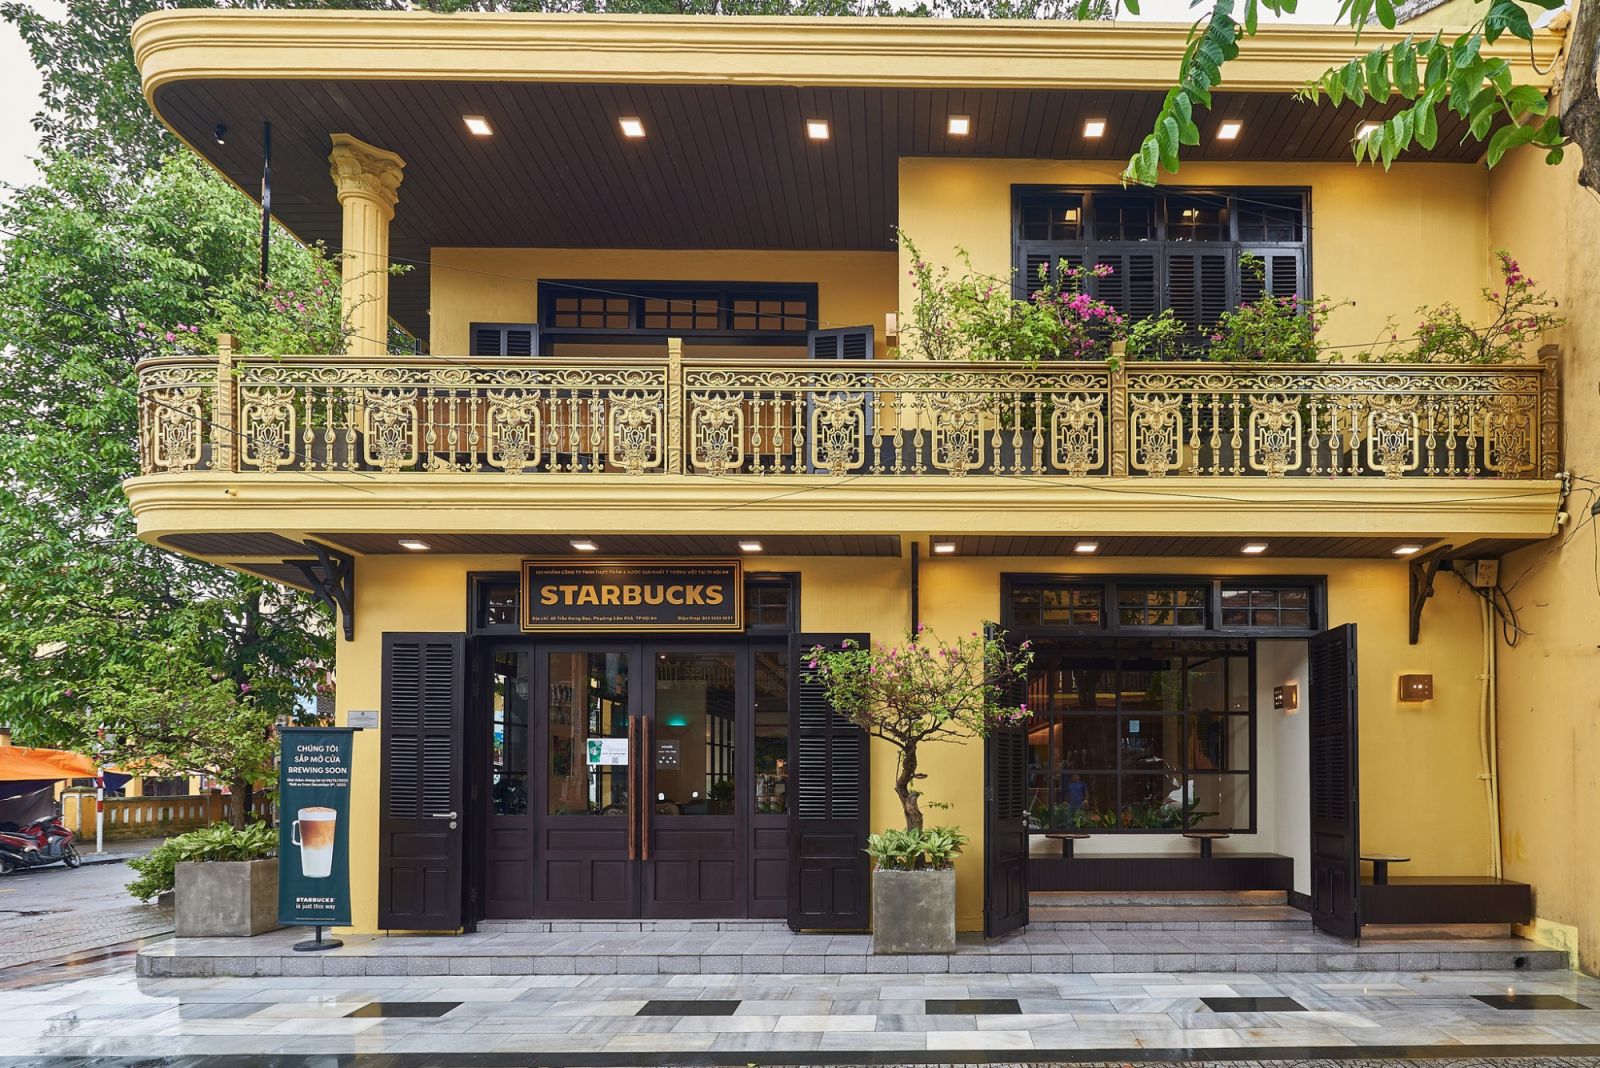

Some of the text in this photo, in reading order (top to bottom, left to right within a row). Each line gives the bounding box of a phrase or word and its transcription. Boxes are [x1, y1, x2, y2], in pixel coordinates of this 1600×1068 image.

[541, 585, 724, 605] STARBUCKS
[297, 744, 339, 752] CHÚNG TÔI
[294, 753, 309, 763] SẮP
